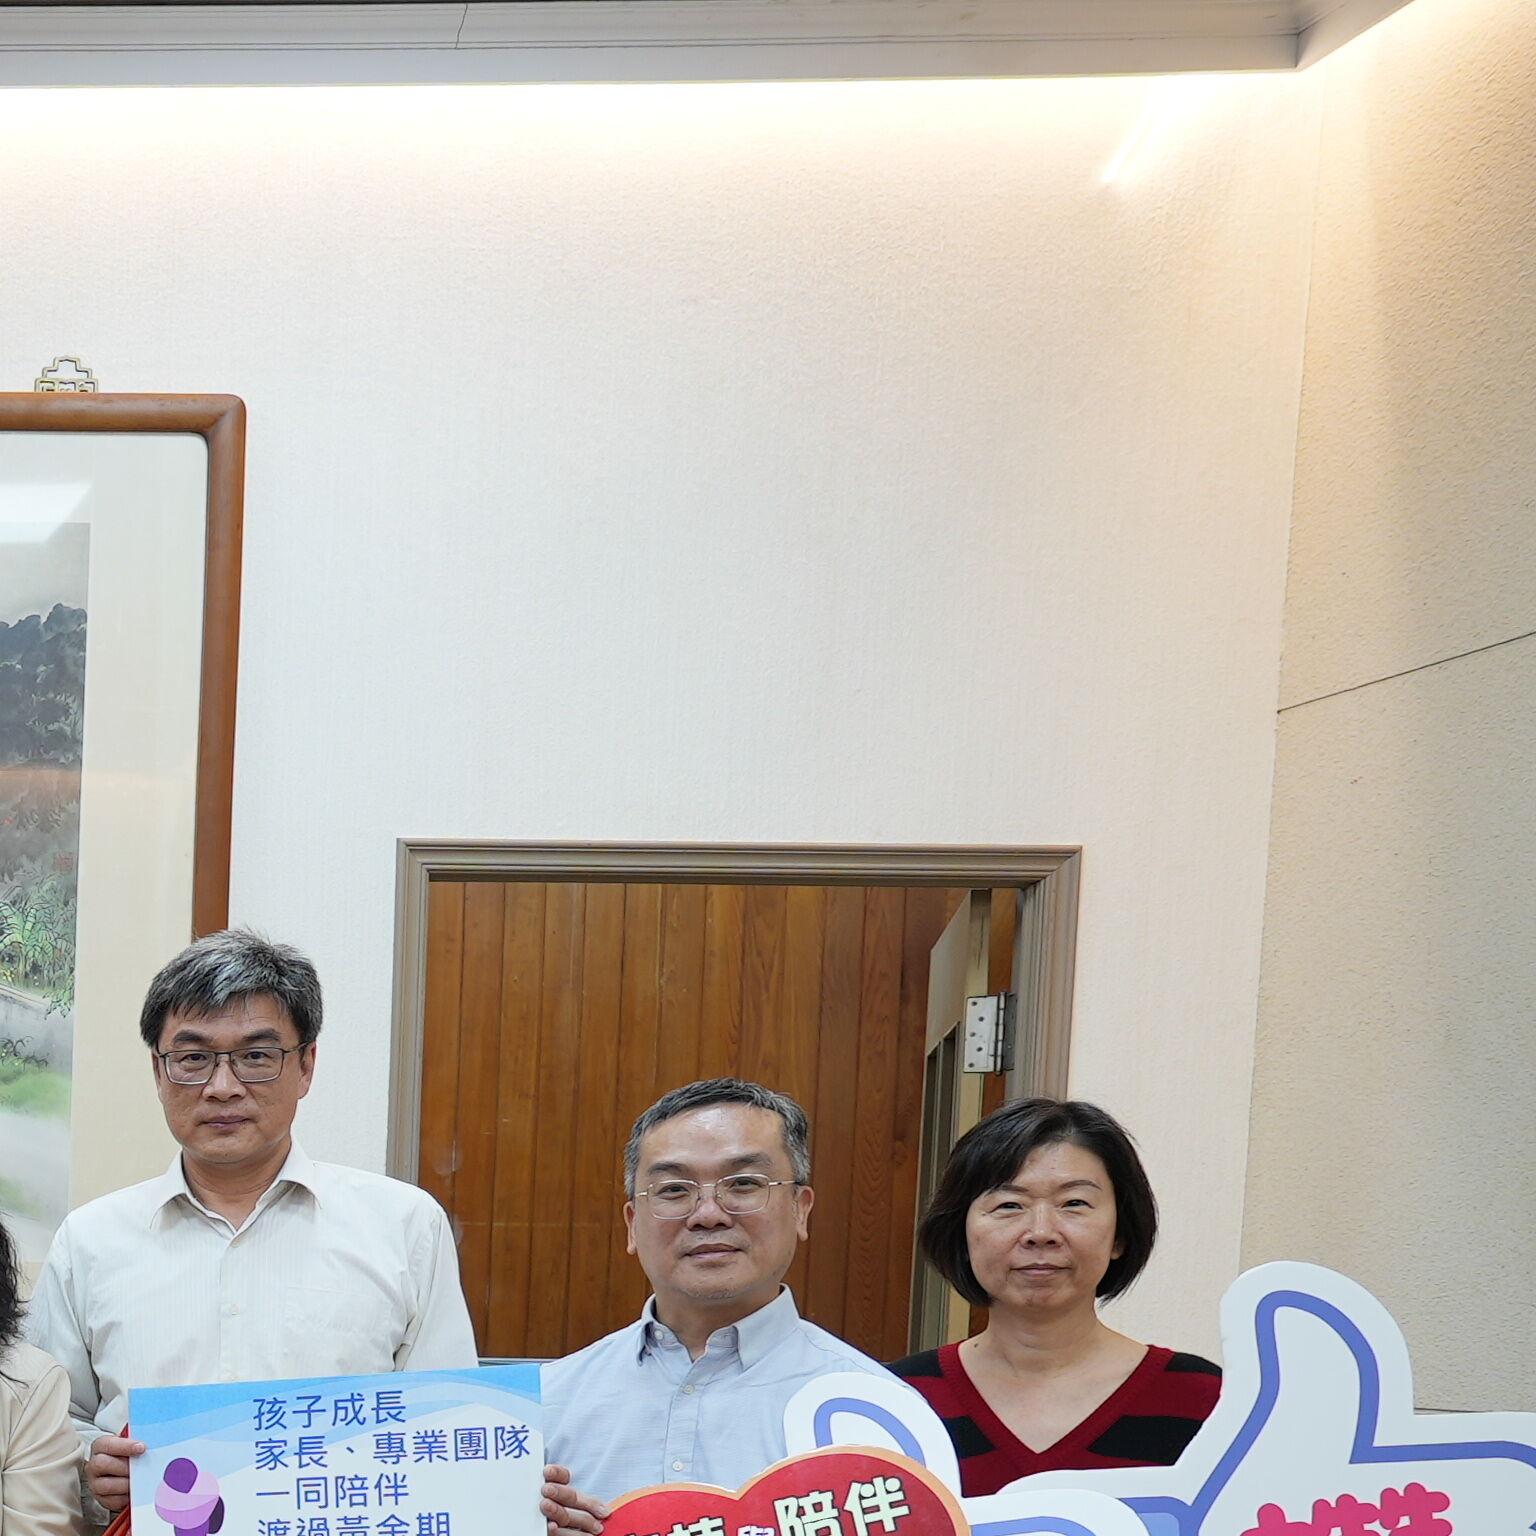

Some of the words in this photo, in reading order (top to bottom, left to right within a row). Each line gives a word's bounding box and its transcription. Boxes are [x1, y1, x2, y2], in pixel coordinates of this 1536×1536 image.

[252, 1389, 408, 1431] 孩子成長
[254, 1424, 531, 1471] 家長、專業團隊
[256, 1472, 409, 1511] 一同陪伴
